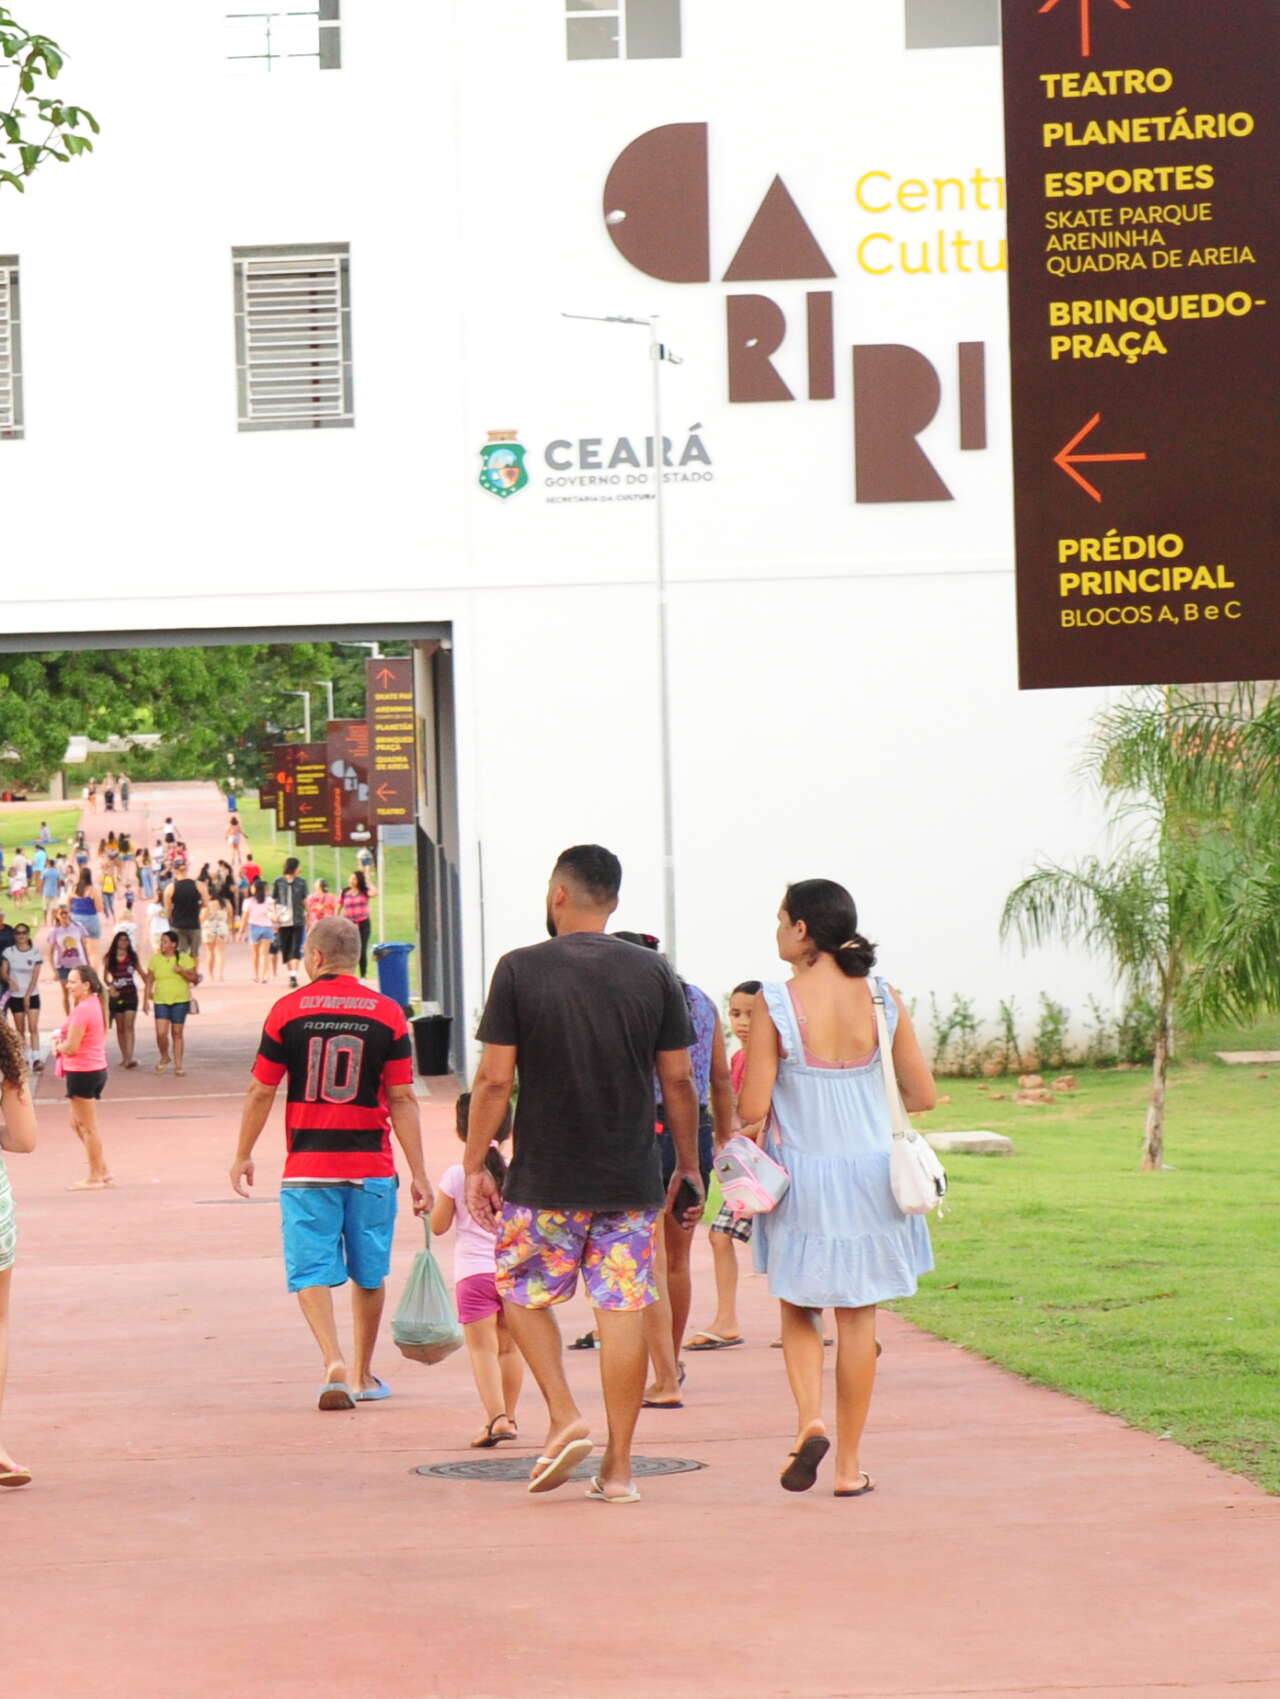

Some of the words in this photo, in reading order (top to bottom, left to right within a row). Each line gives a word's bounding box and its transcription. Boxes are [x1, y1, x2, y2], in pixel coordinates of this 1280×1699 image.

[1039, 67, 1174, 99] TEATRO
[1042, 106, 1255, 148] PLANETÁRIO
[1044, 164, 1215, 198] ESPORTES
[1045, 207, 1113, 230] SKATE
[1118, 202, 1213, 226] PARQUE
[1046, 228, 1166, 252] ARENINHA
[1045, 251, 1147, 277] QUADRA
[1151, 249, 1183, 269] DE
[1187, 245, 1257, 267] AREIA
[1048, 290, 1267, 327] BRINQUEDO-
[1050, 330, 1168, 365] PRAÇA
[544, 421, 713, 471] CEARÁ
[544, 474, 621, 488] GOVERNO
[626, 473, 649, 486] DO
[661, 471, 714, 484] STADO
[1057, 528, 1184, 563] PRÉDIO
[1058, 564, 1236, 598] PRINCIPAL
[1060, 605, 1153, 628] BLOCOS
[1157, 605, 1179, 624] A,
[1183, 603, 1200, 621] B
[1203, 604, 1219, 620] e
[1223, 600, 1242, 619] C
[299, 995, 378, 1011] OLYMPIKUS
[304, 1034, 365, 1105] 10
